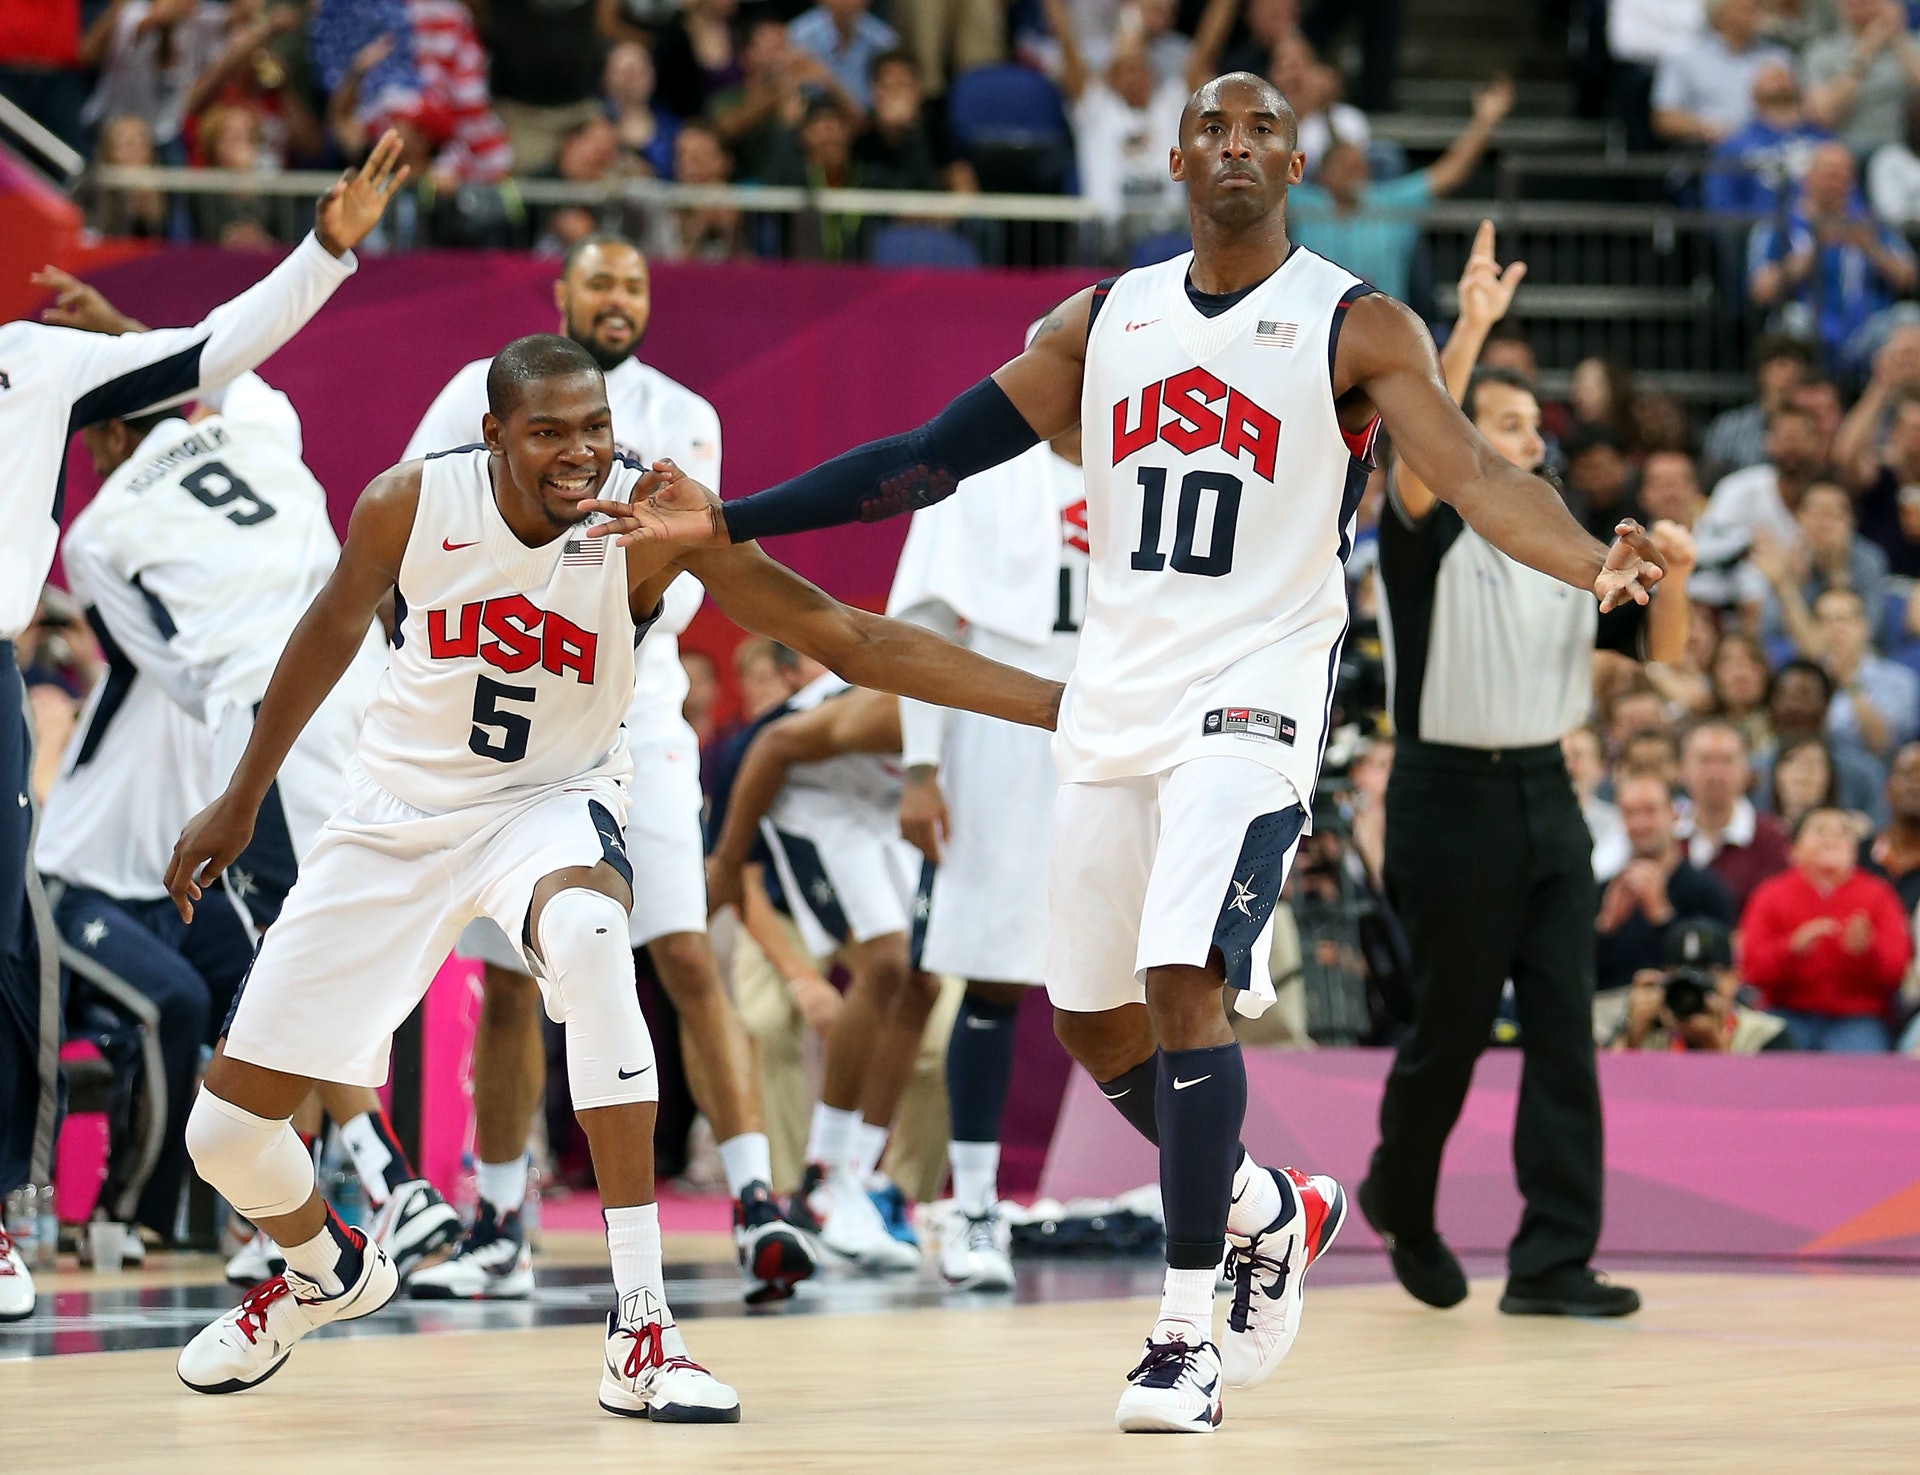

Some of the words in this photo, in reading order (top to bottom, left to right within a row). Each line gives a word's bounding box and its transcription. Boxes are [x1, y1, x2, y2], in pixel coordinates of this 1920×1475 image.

[1112, 366, 1281, 484] USA
[180, 462, 276, 525] 9
[1131, 466, 1243, 577] 10
[428, 594, 598, 685] USA
[468, 674, 536, 762] 5
[1255, 713, 1270, 724] 56
